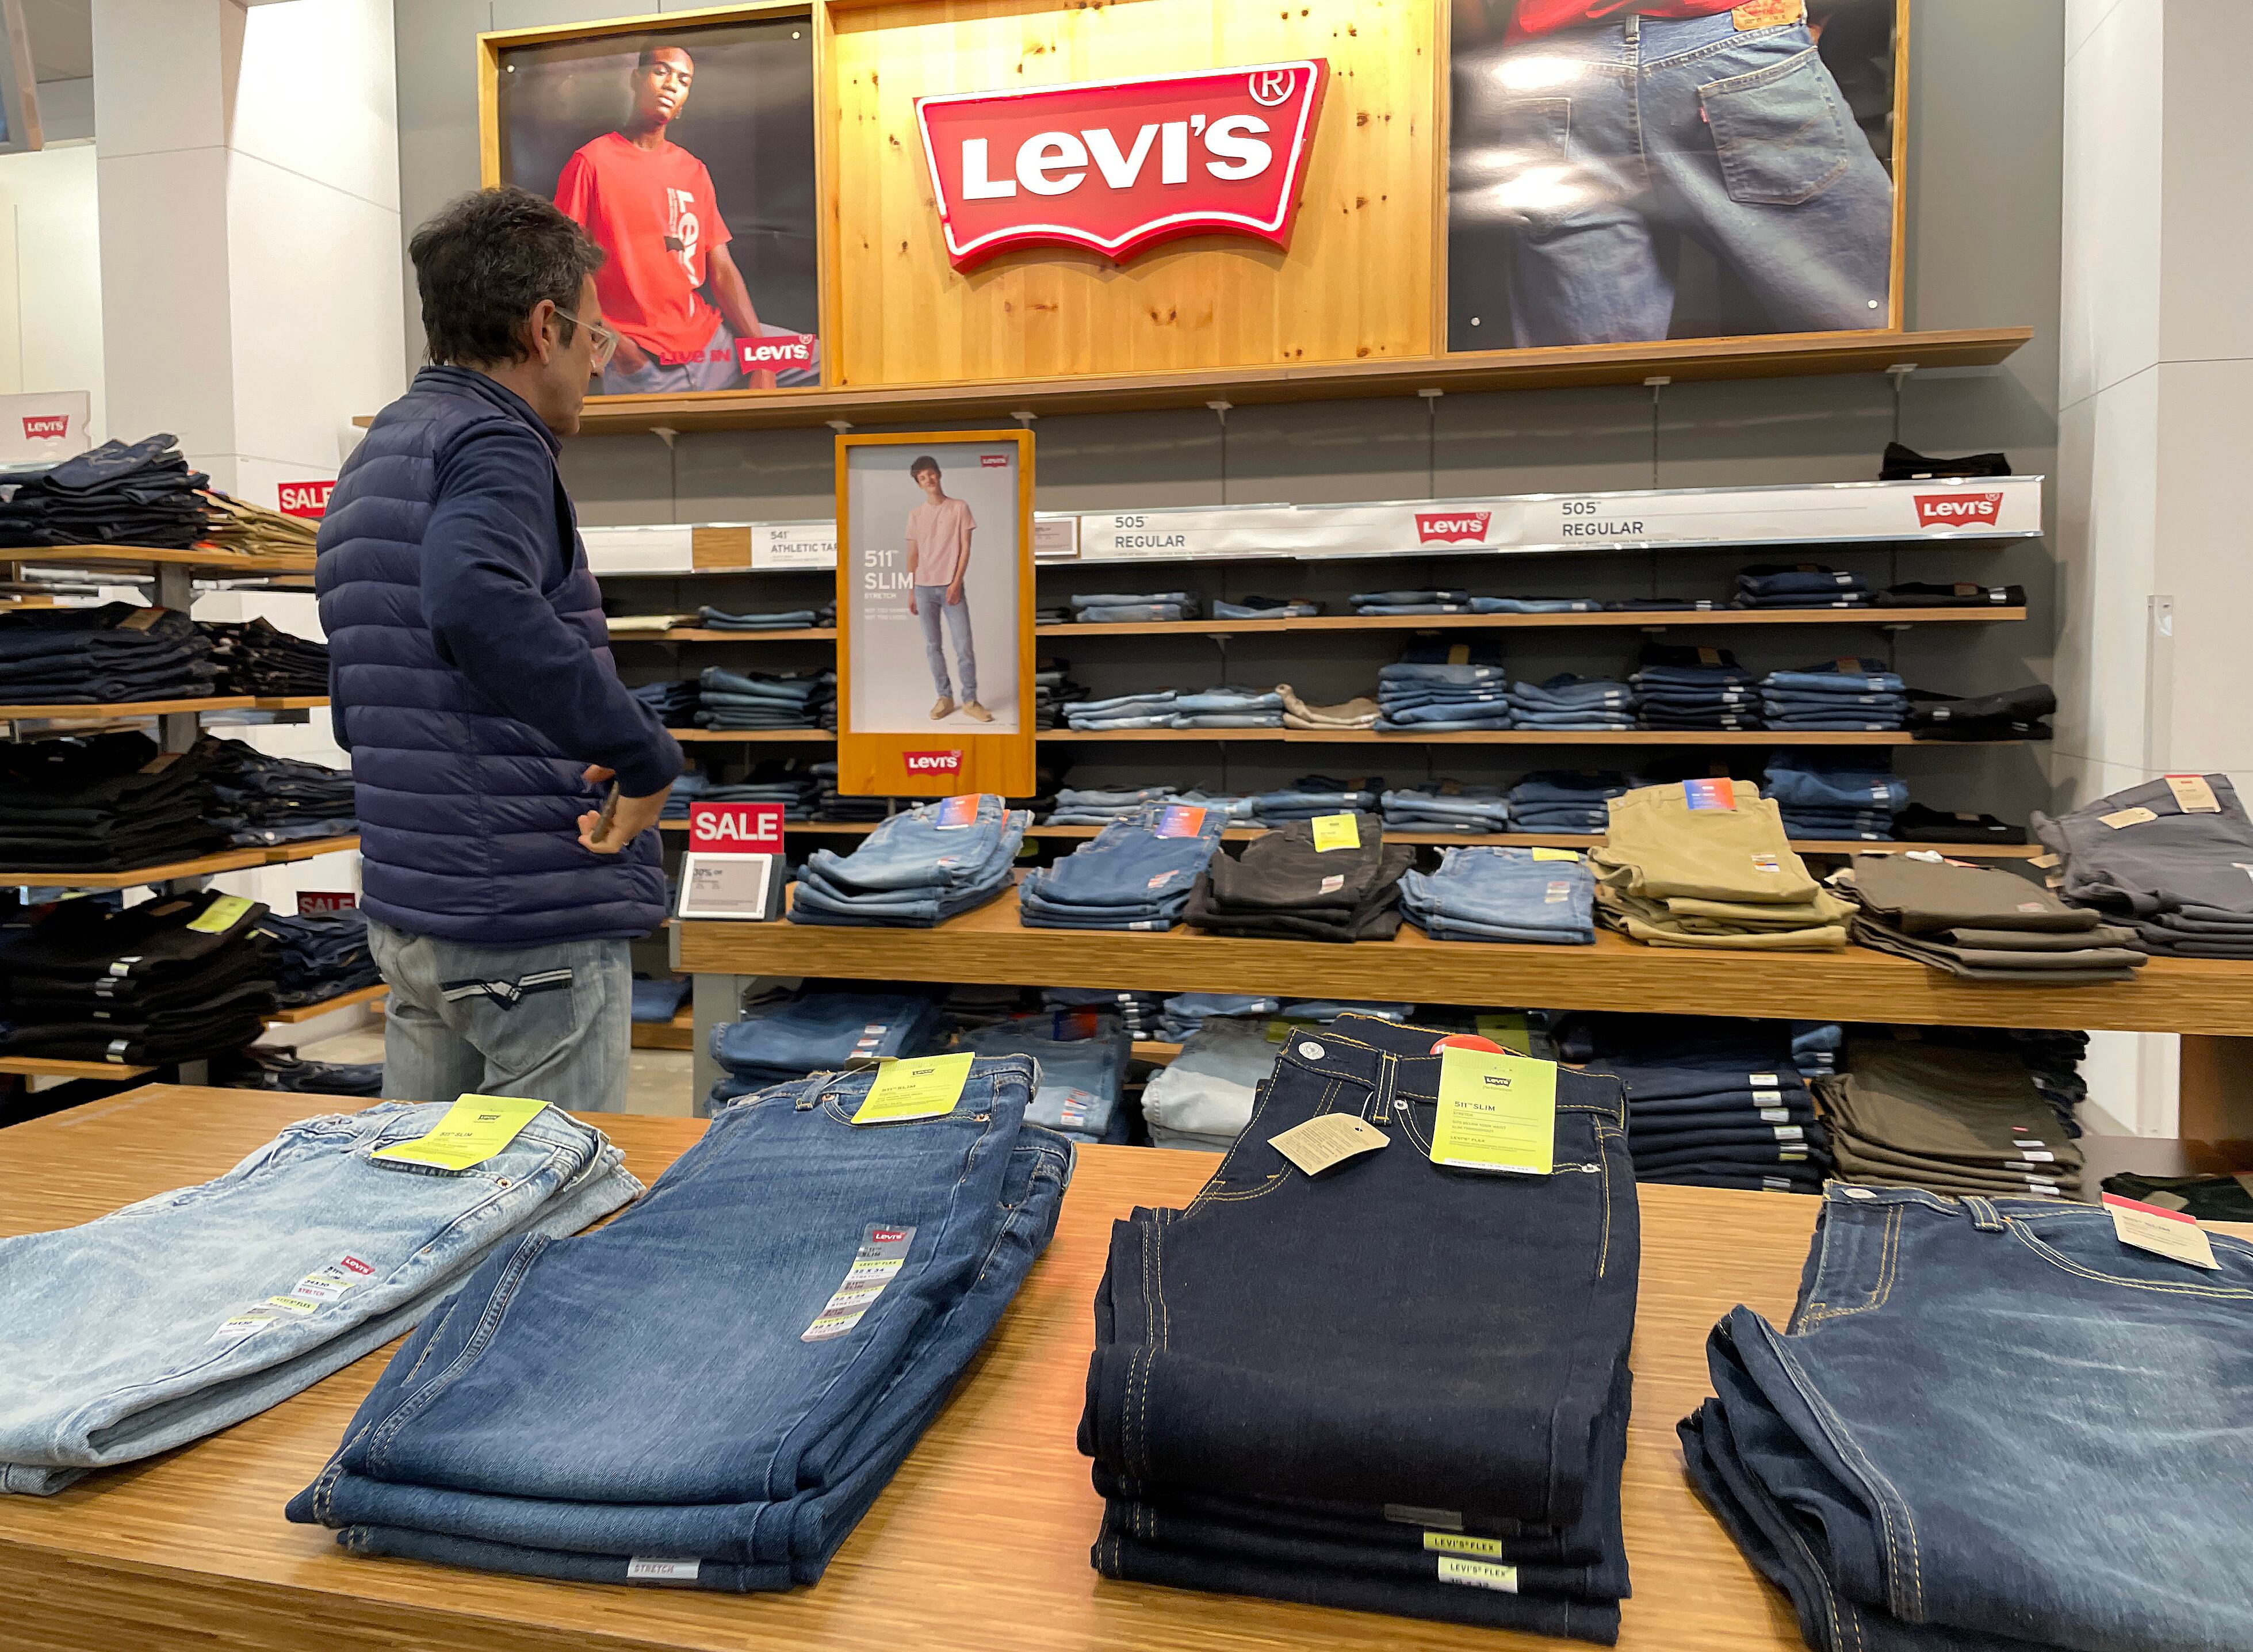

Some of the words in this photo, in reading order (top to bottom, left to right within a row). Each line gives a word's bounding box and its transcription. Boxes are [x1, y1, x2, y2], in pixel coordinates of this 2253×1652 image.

[710, 349, 731, 363] IN
[1562, 522, 1644, 537] REGULAR
[1114, 535, 1185, 548] REGULAR
[771, 543, 818, 553] ATHLETIC
[865, 572, 913, 590] SLIM
[695, 811, 779, 841] SALE
[1473, 1104, 1495, 1112] SLIM
[1470, 1542, 1494, 1552] FLEX
[634, 1563, 675, 1574] STRETCH
[1485, 1567, 1506, 1577] FLEX
